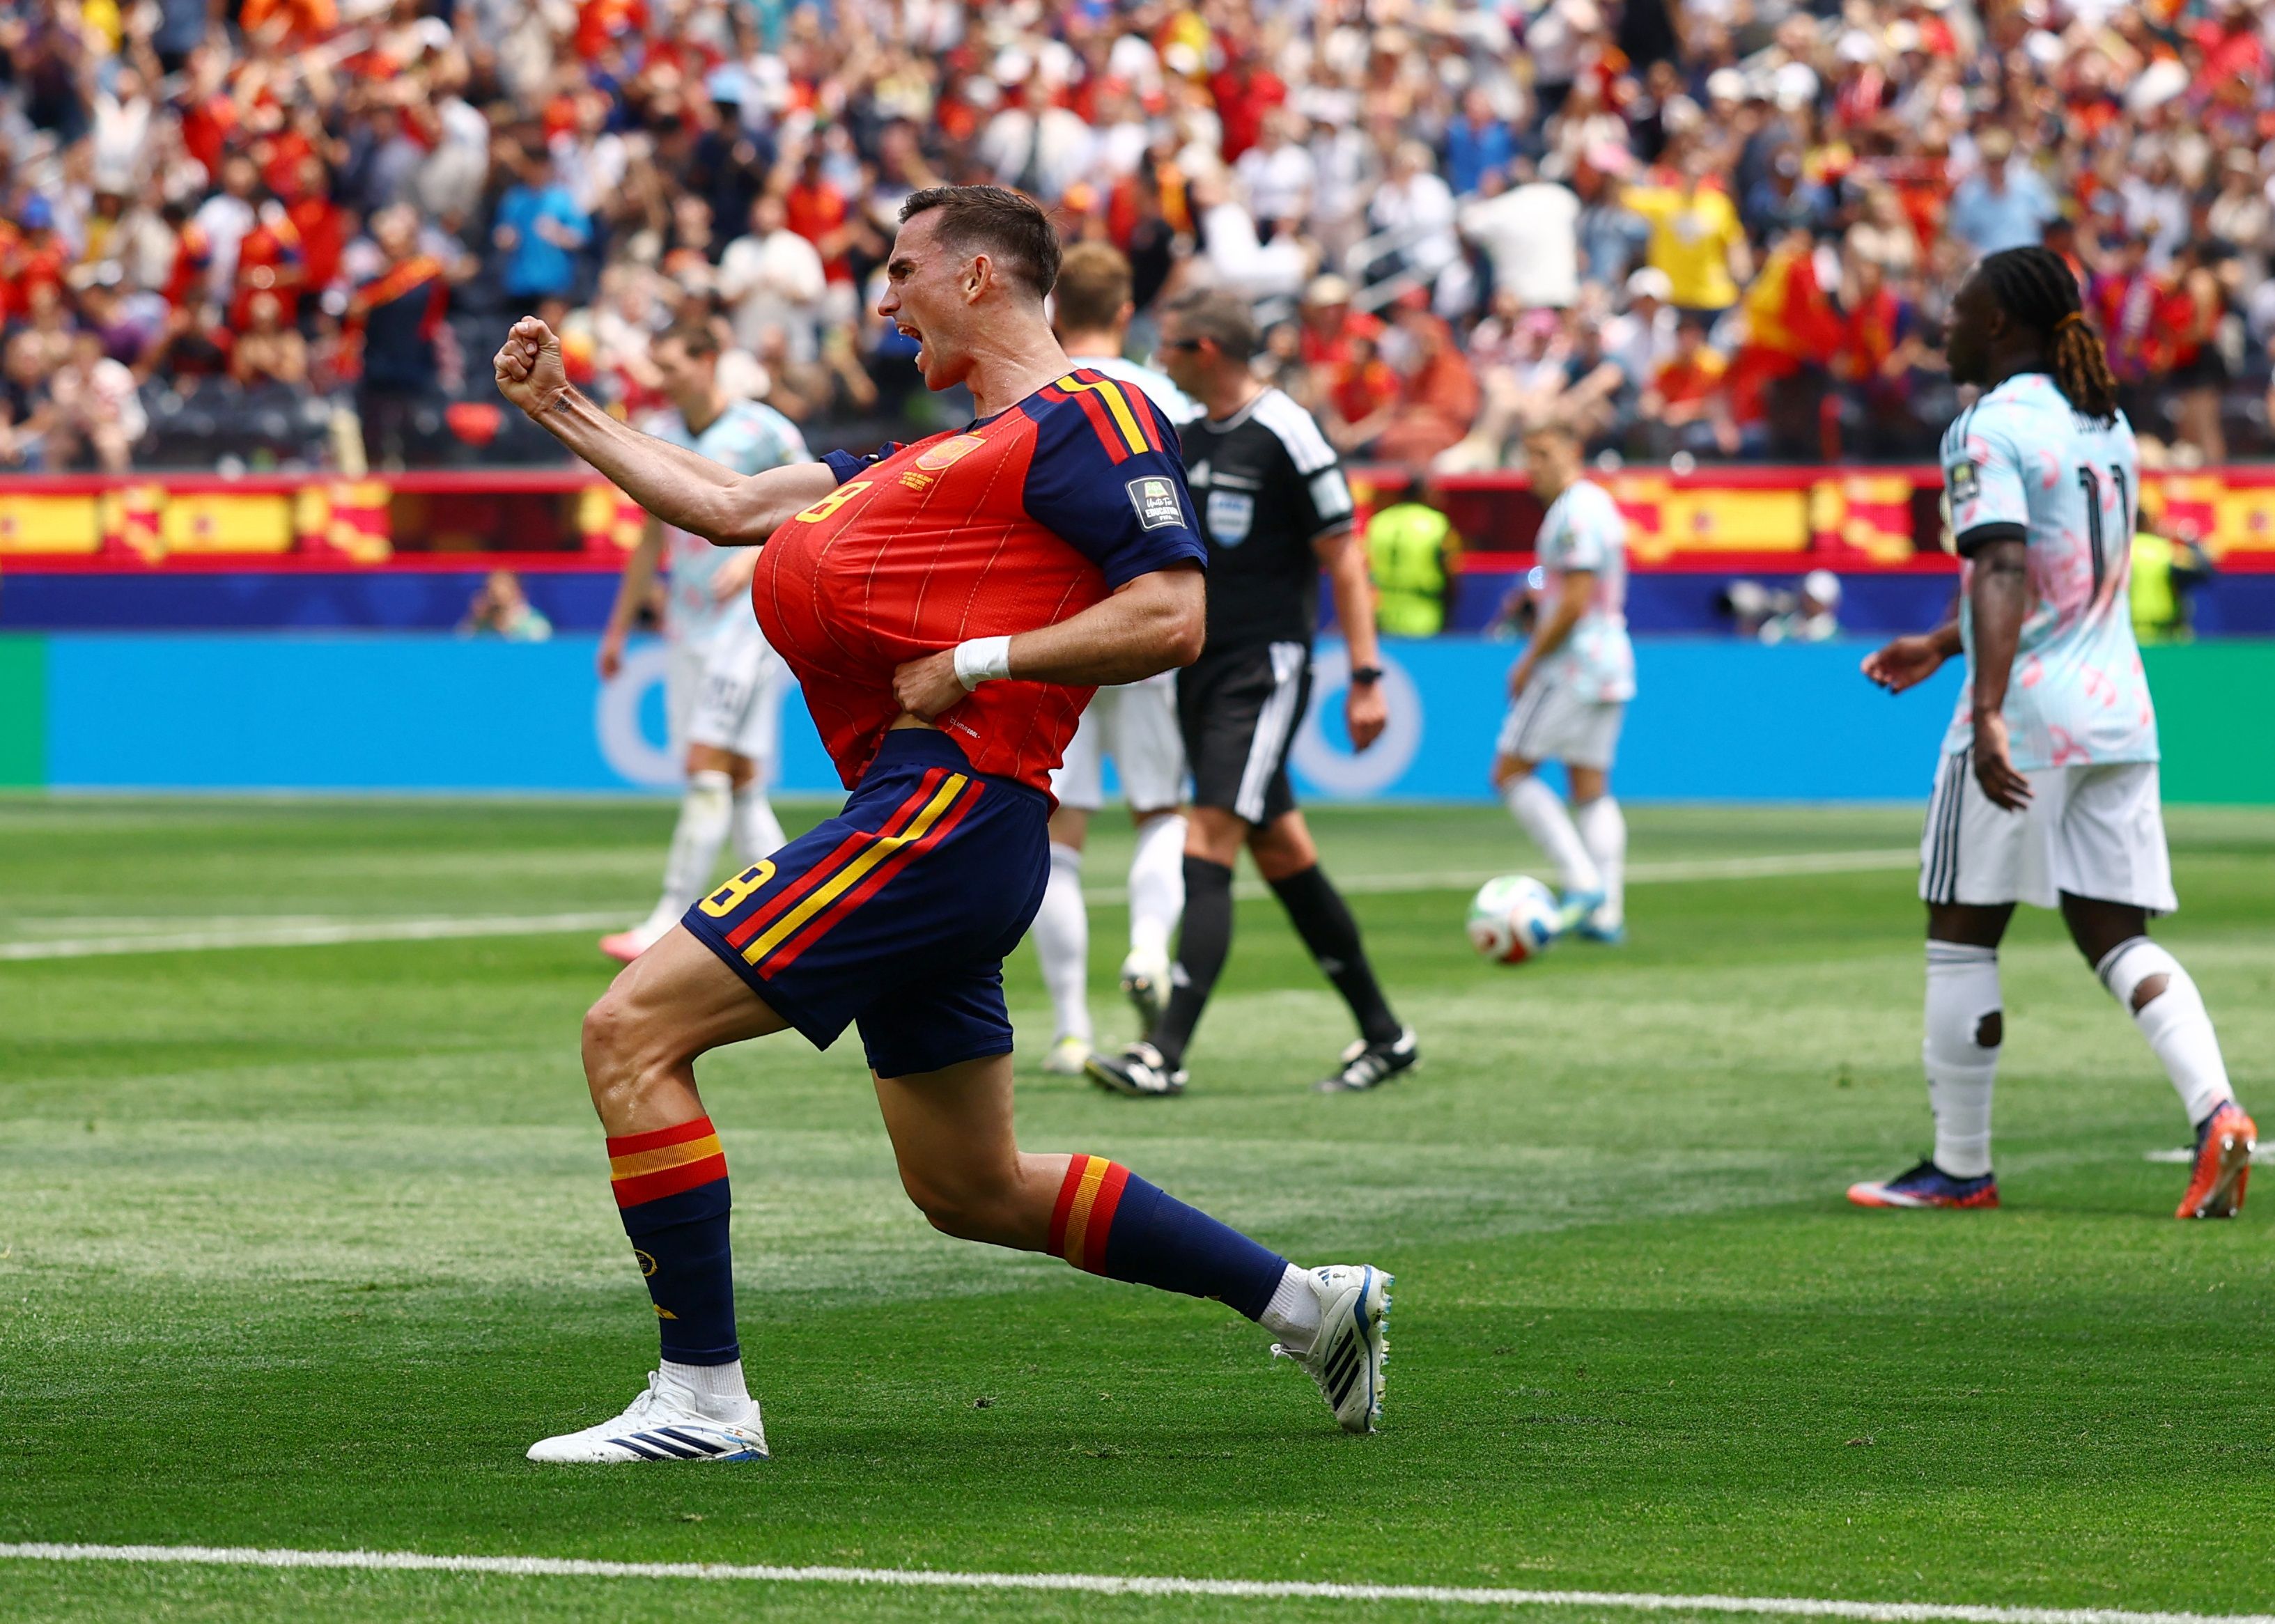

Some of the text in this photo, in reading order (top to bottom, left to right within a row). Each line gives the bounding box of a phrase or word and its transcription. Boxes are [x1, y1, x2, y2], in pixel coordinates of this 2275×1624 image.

[795, 481, 873, 523] 8
[2079, 466, 2129, 610] 11
[699, 859, 776, 917] 8
